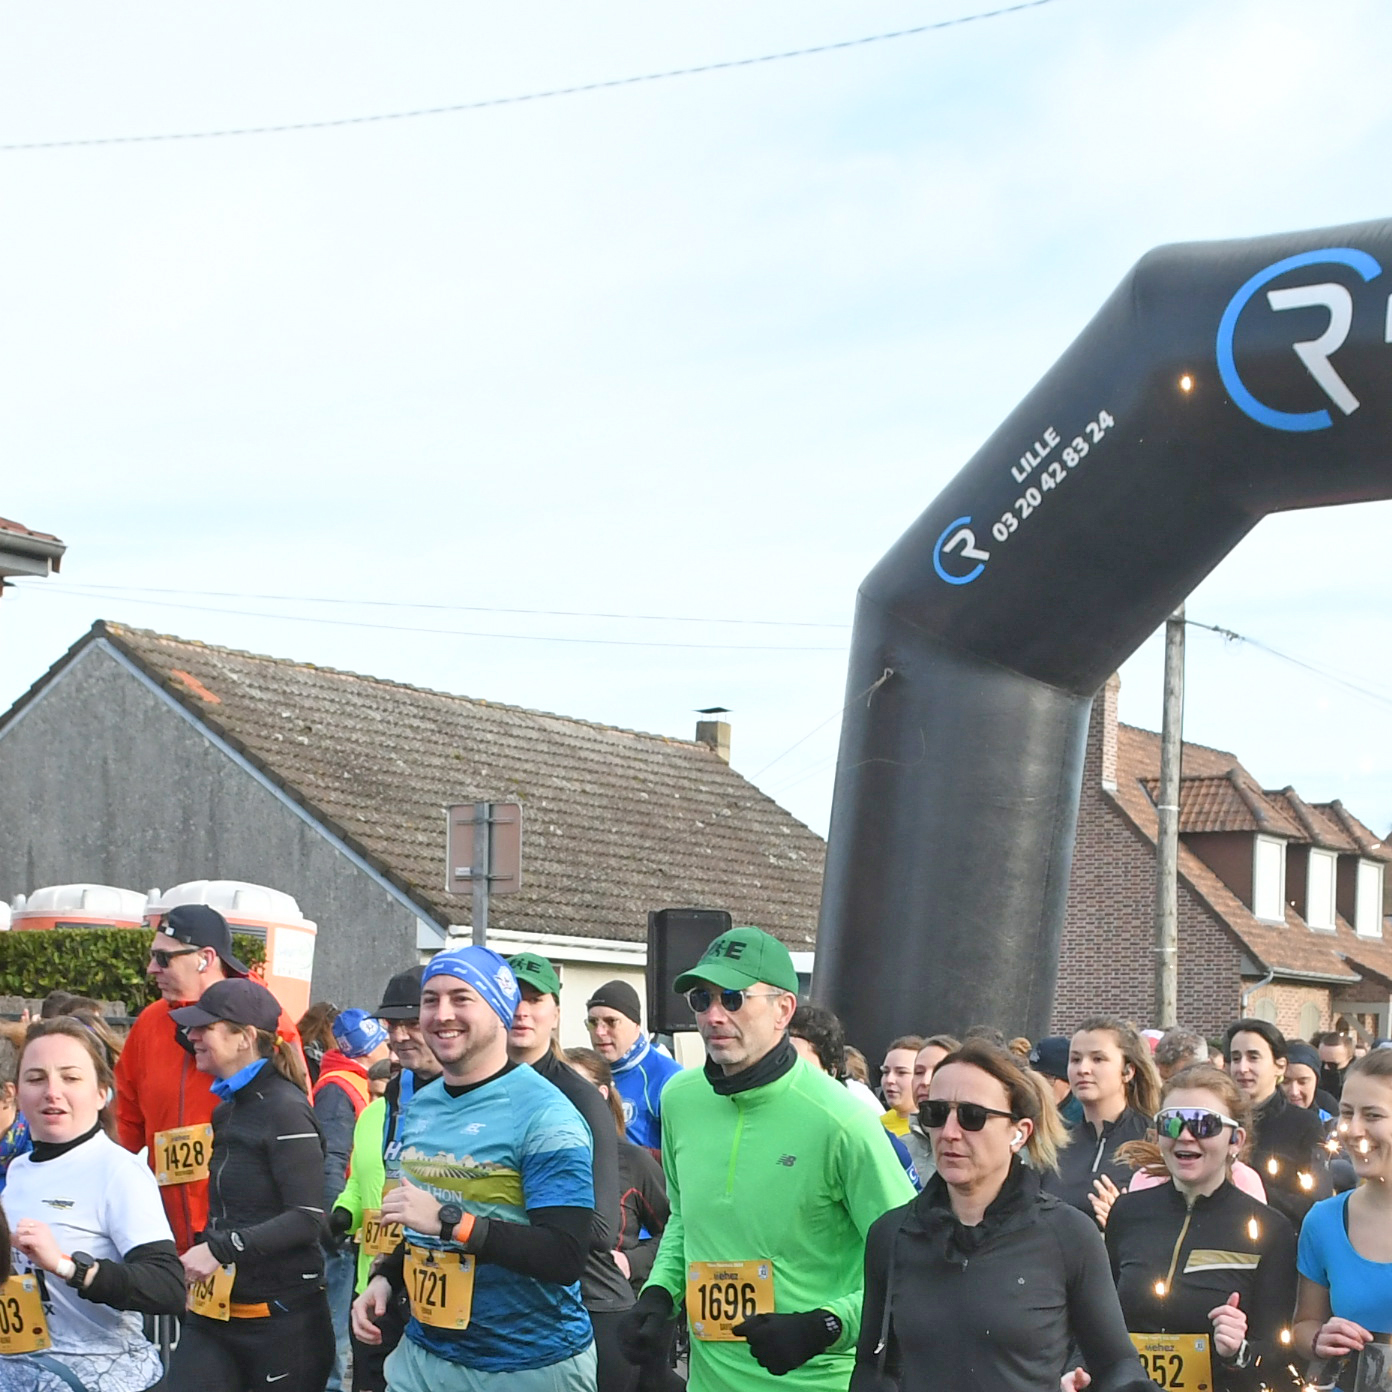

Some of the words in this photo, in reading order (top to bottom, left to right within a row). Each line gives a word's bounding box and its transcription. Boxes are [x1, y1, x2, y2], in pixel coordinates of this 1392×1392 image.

[1011, 426, 1061, 483] LILLE
[992, 511, 1019, 542] 03
[1014, 487, 1042, 519] 20
[1040, 461, 1067, 492] 42
[1062, 436, 1089, 468] 83
[1085, 410, 1115, 443] 24
[163, 1140, 204, 1171] 1428
[413, 1268, 447, 1308] 1721
[698, 1282, 757, 1321] 1696
